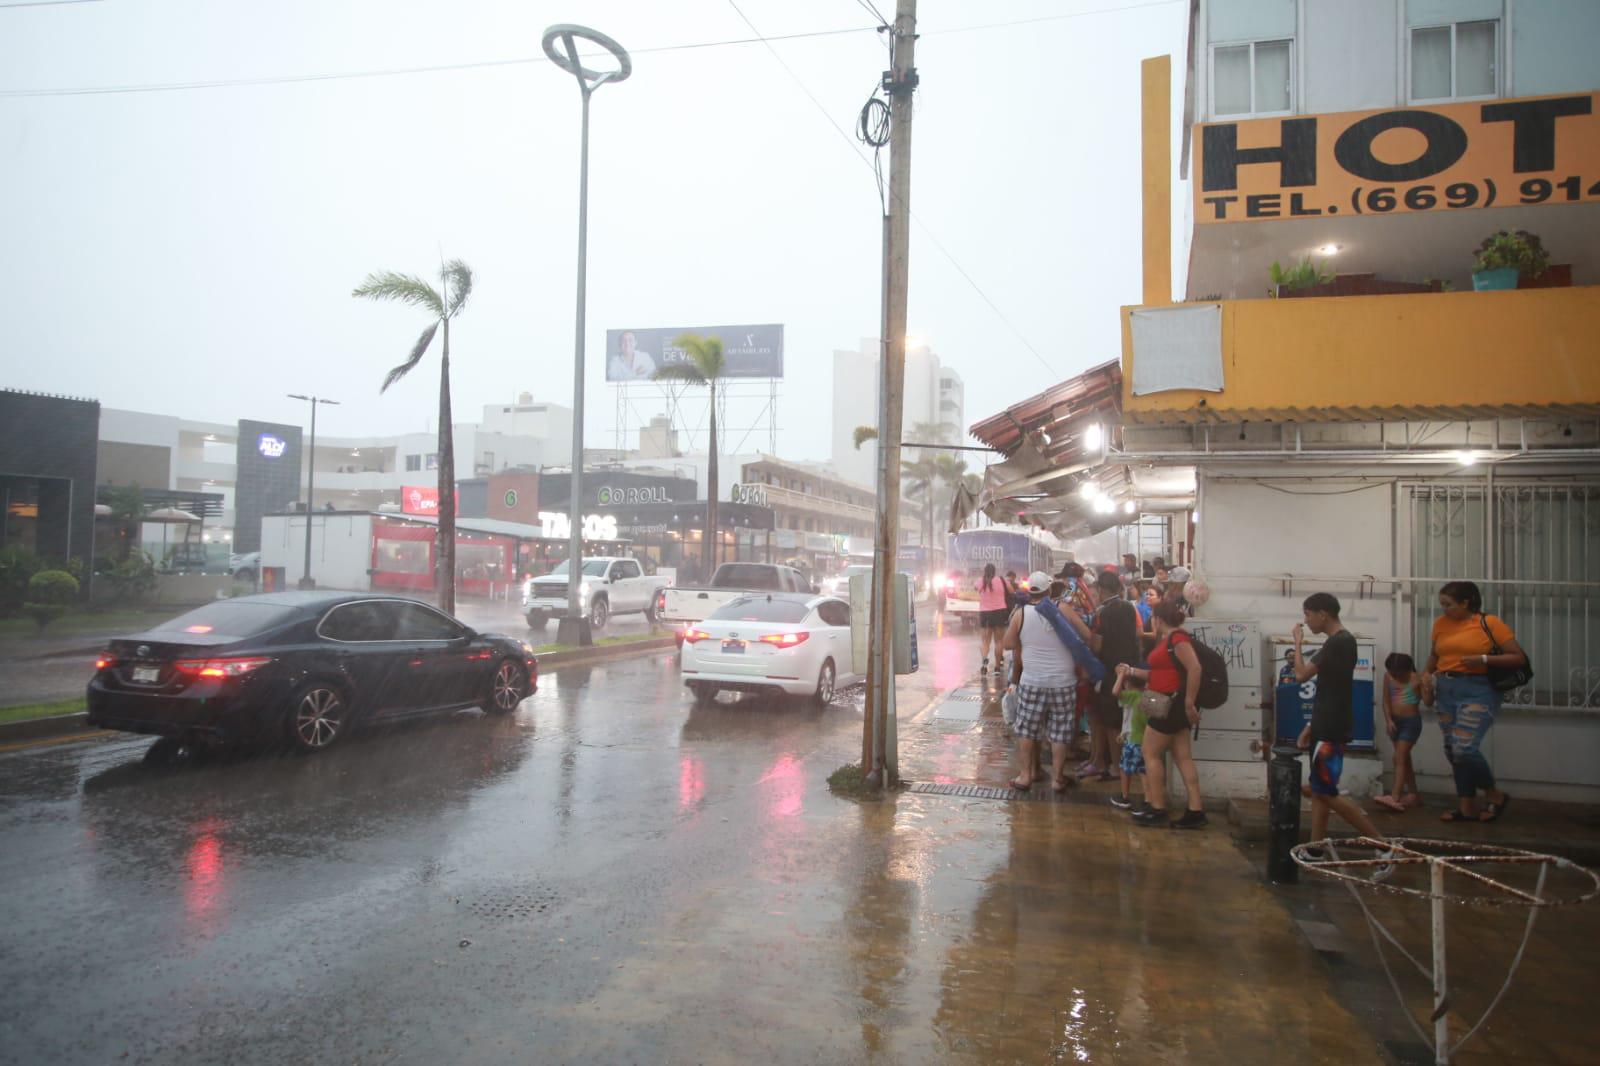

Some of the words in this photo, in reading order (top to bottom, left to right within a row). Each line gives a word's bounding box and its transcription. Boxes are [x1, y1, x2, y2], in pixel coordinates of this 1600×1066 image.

[1203, 193, 1338, 219] TEL.
[1351, 178, 1497, 214] (669)
[626, 486, 673, 504] ROLL
[972, 545, 1004, 560] GUSTO
[1298, 680, 1316, 699] 3
